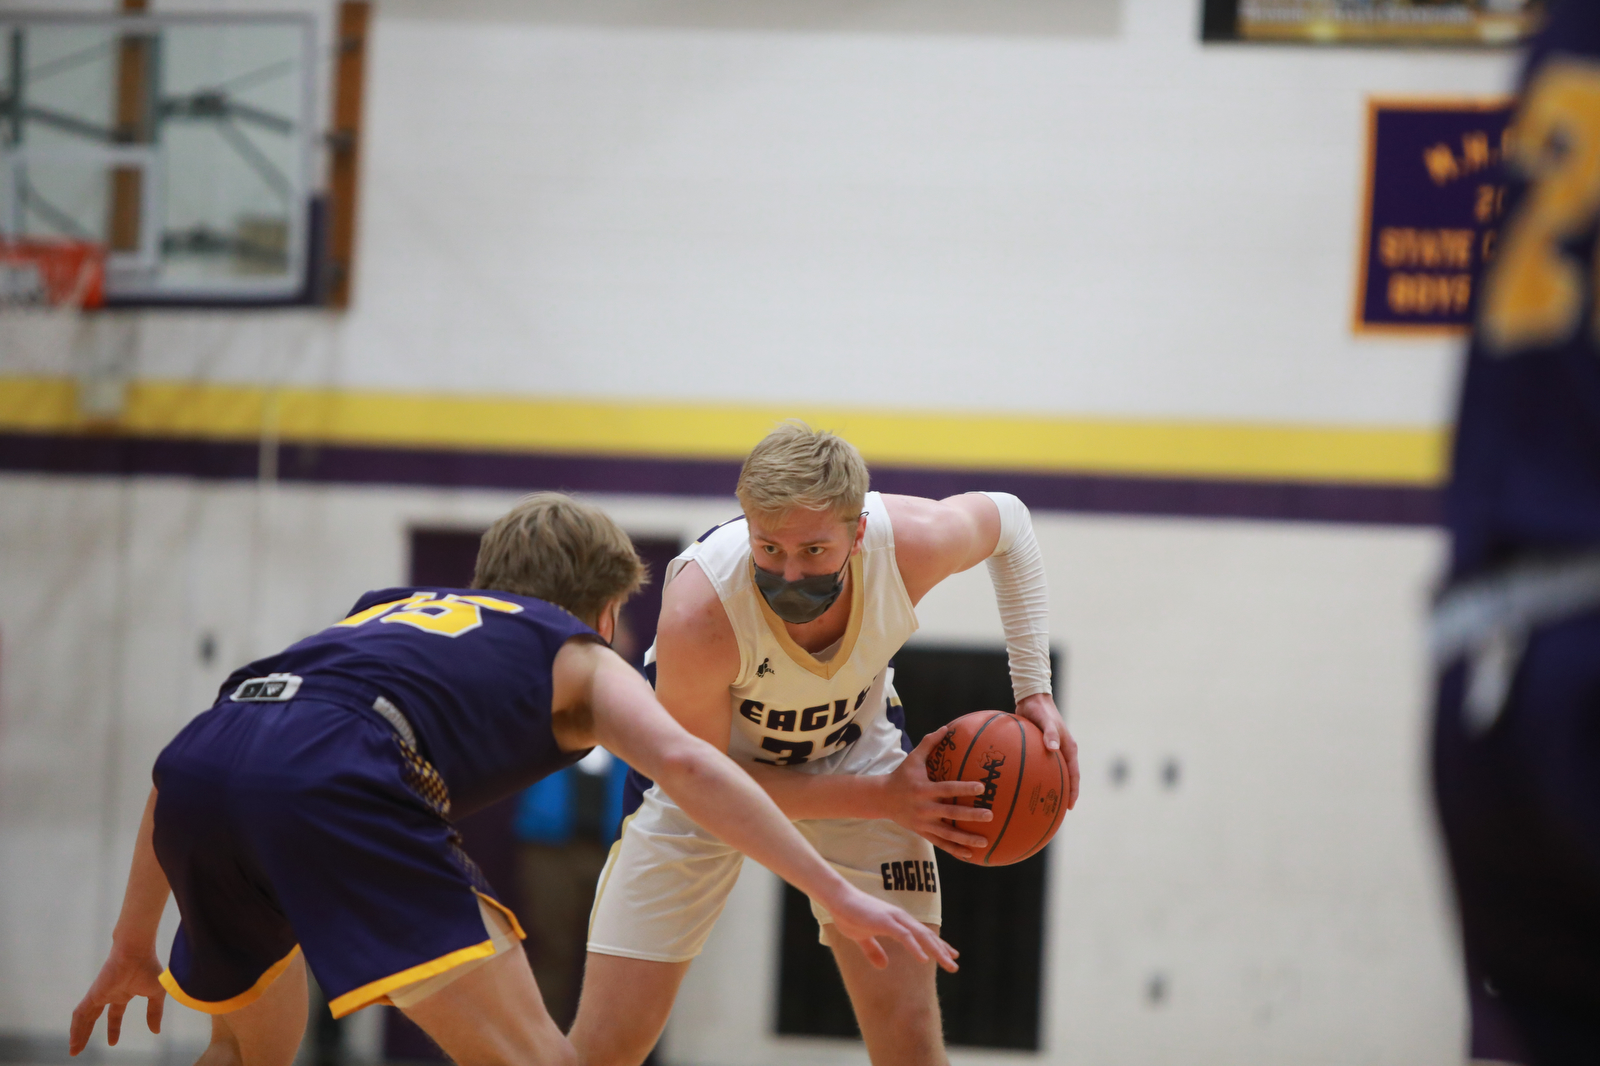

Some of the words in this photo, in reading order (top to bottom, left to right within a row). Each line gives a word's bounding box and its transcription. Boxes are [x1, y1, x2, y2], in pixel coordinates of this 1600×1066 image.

[1480, 55, 1600, 352] 2
[1380, 228, 1474, 267] STATE
[333, 591, 525, 638] 15
[740, 675, 878, 732] EAGLE
[881, 860, 937, 893] EAGLES
